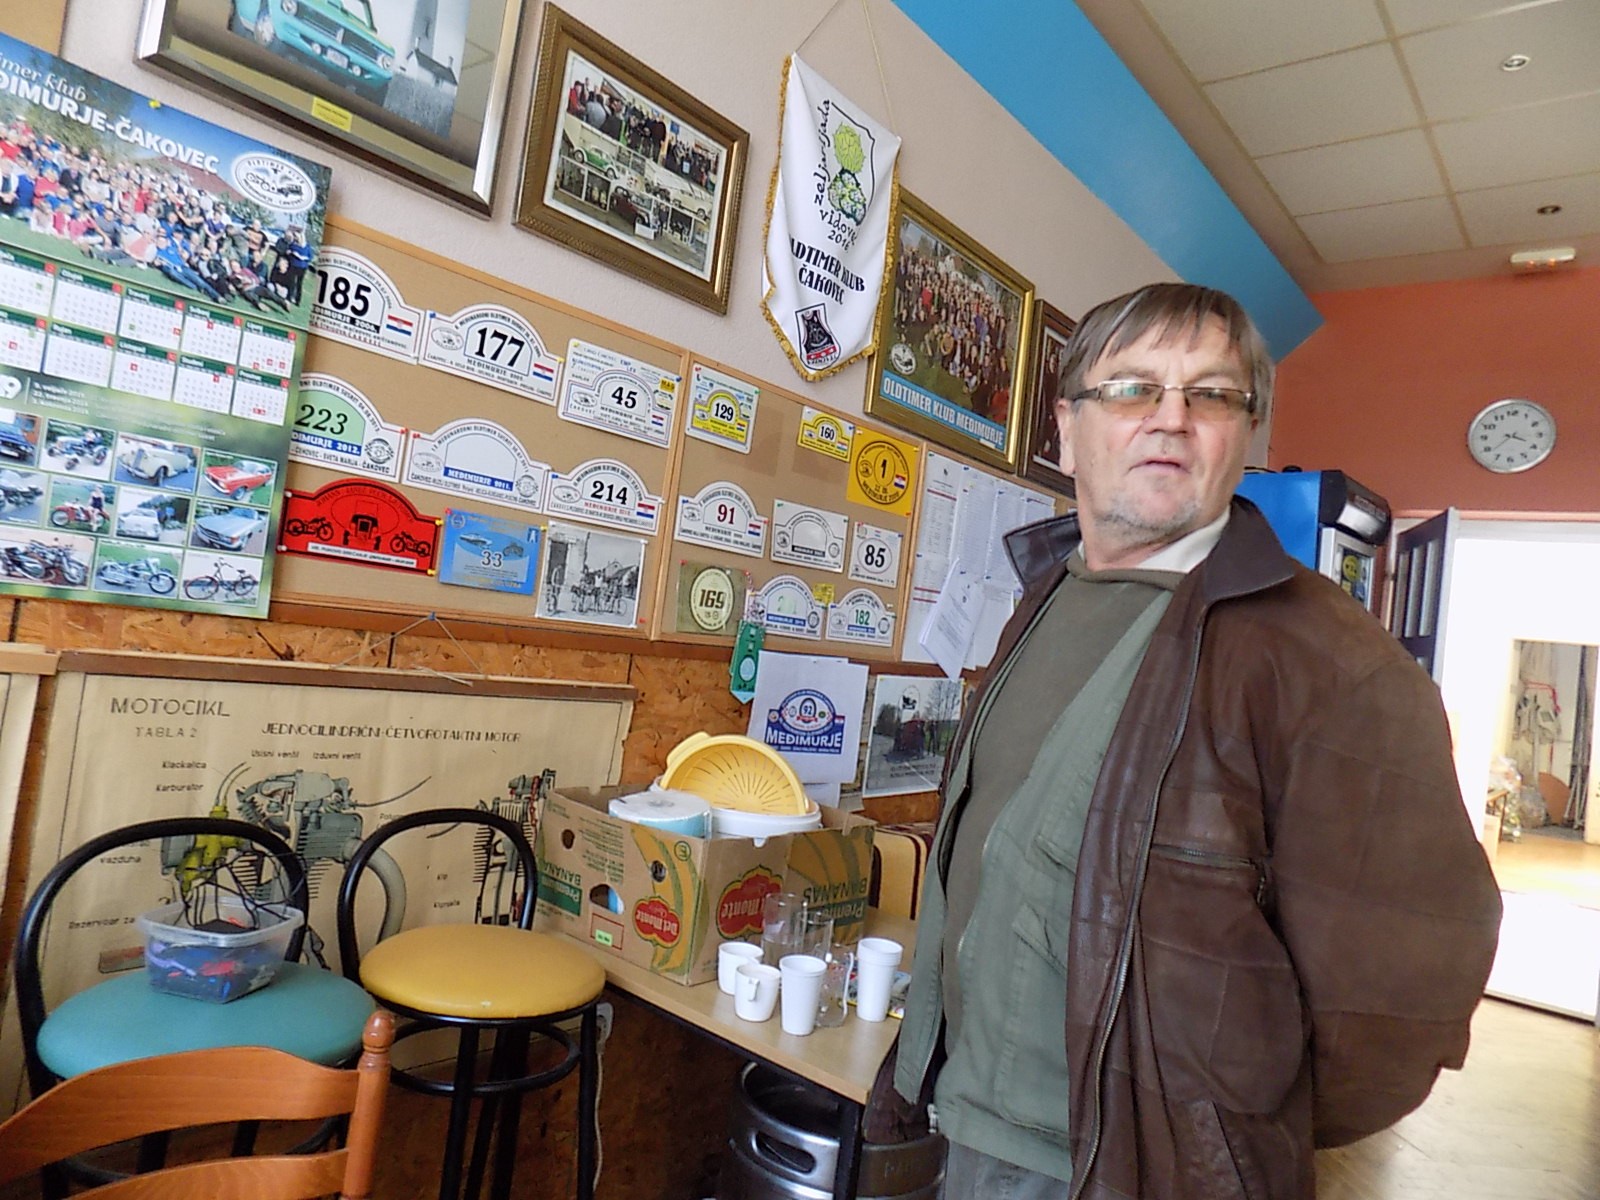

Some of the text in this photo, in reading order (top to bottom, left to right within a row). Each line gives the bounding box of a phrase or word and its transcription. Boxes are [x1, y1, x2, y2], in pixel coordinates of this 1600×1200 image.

[0, 52, 87, 101] mer klub
[790, 234, 841, 278] LDTIMER
[317, 269, 372, 317] 185
[475, 327, 525, 367] 177
[611, 386, 638, 409] 45
[883, 378, 932, 413] OLDTIMER
[933, 401, 956, 423] KLUB
[294, 404, 348, 435] 223
[715, 402, 734, 422] 129
[820, 426, 835, 441] 160
[881, 459, 888, 479] 1
[591, 481, 628, 505] 214
[717, 504, 735, 525] 91
[482, 551, 502, 568] 33
[864, 544, 886, 568] 85
[699, 589, 727, 609] 169
[855, 609, 871, 625] 182
[110, 697, 230, 717] MOTOCIKL
[803, 705, 813, 715] 92
[135, 726, 198, 738] TABLA 2
[484, 731, 522, 743] MOTOR
[156, 783, 203, 792] Karburator
[803, 877, 868, 903] BANANAS
[721, 897, 761, 919] Monte
[636, 910, 678, 936] Del Monte
